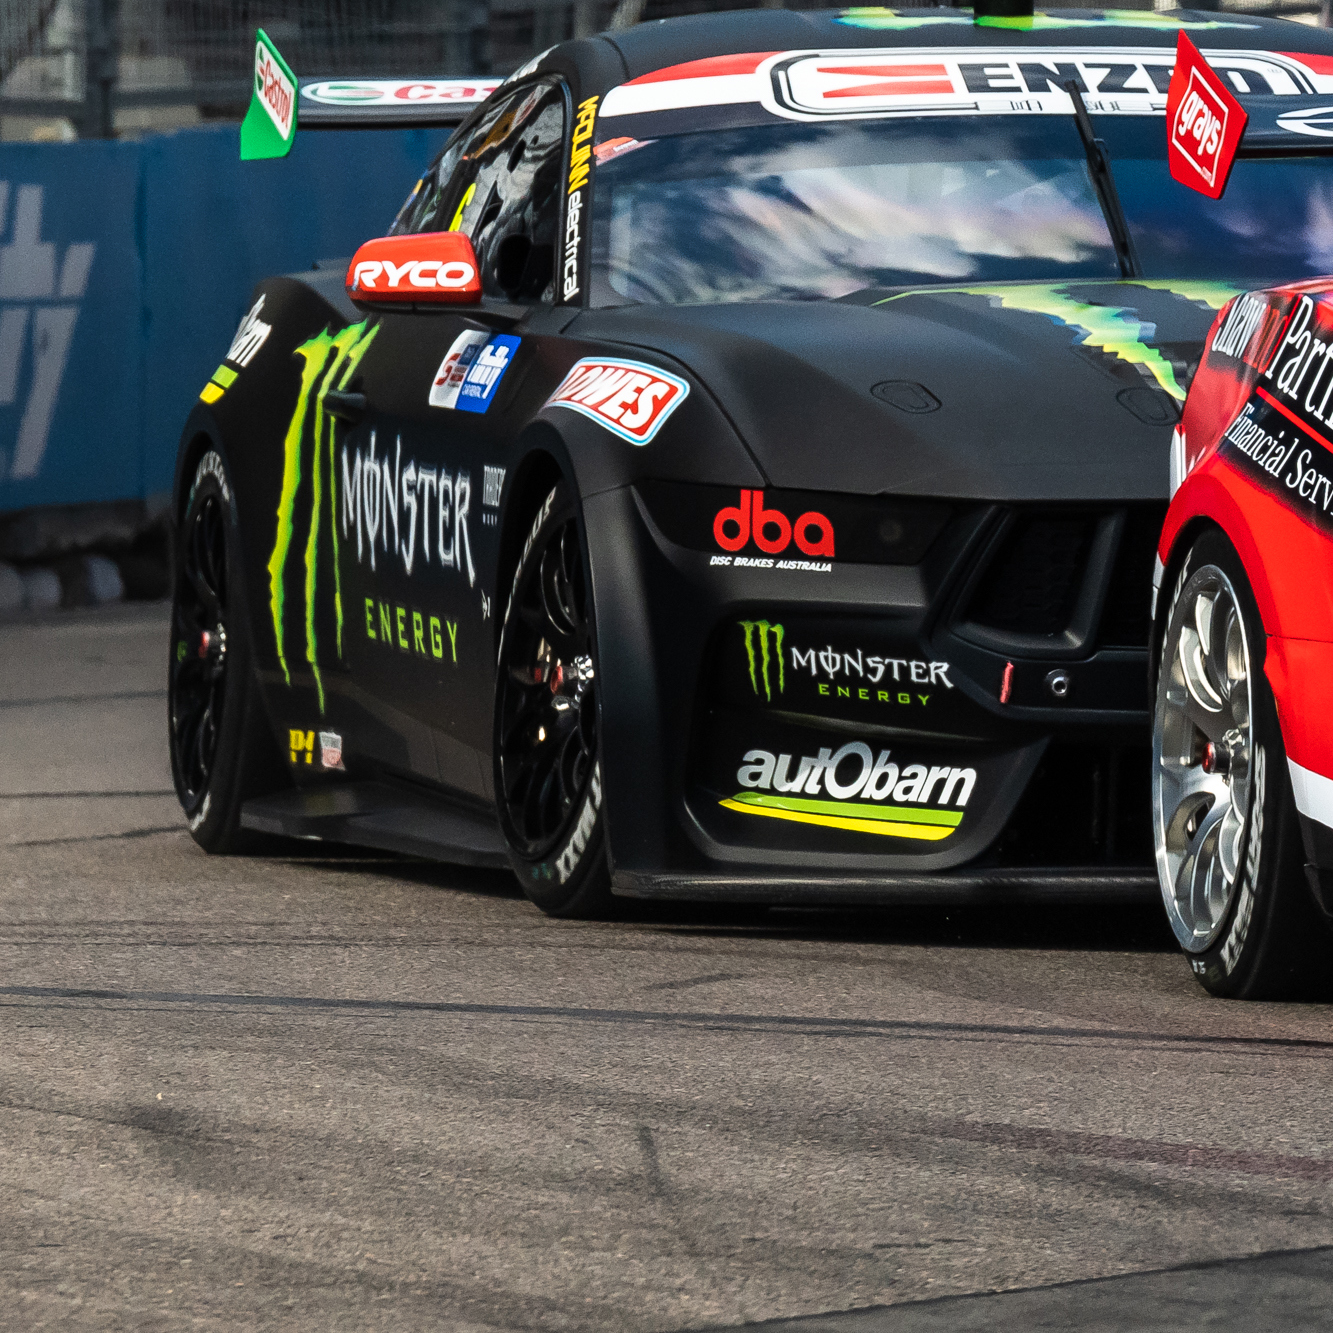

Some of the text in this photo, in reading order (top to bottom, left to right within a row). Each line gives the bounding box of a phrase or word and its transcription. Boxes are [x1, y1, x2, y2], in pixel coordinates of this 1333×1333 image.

[1177, 89, 1222, 156] grays
[563, 190, 584, 302] electrical
[353, 260, 476, 289] RYCO
[712, 488, 836, 558] dba
[709, 555, 833, 573] DISC BRAKES AUSTRALIA
[364, 596, 459, 663] ENERGY
[789, 645, 957, 690] MONSTER
[818, 683, 932, 707] ENERGY
